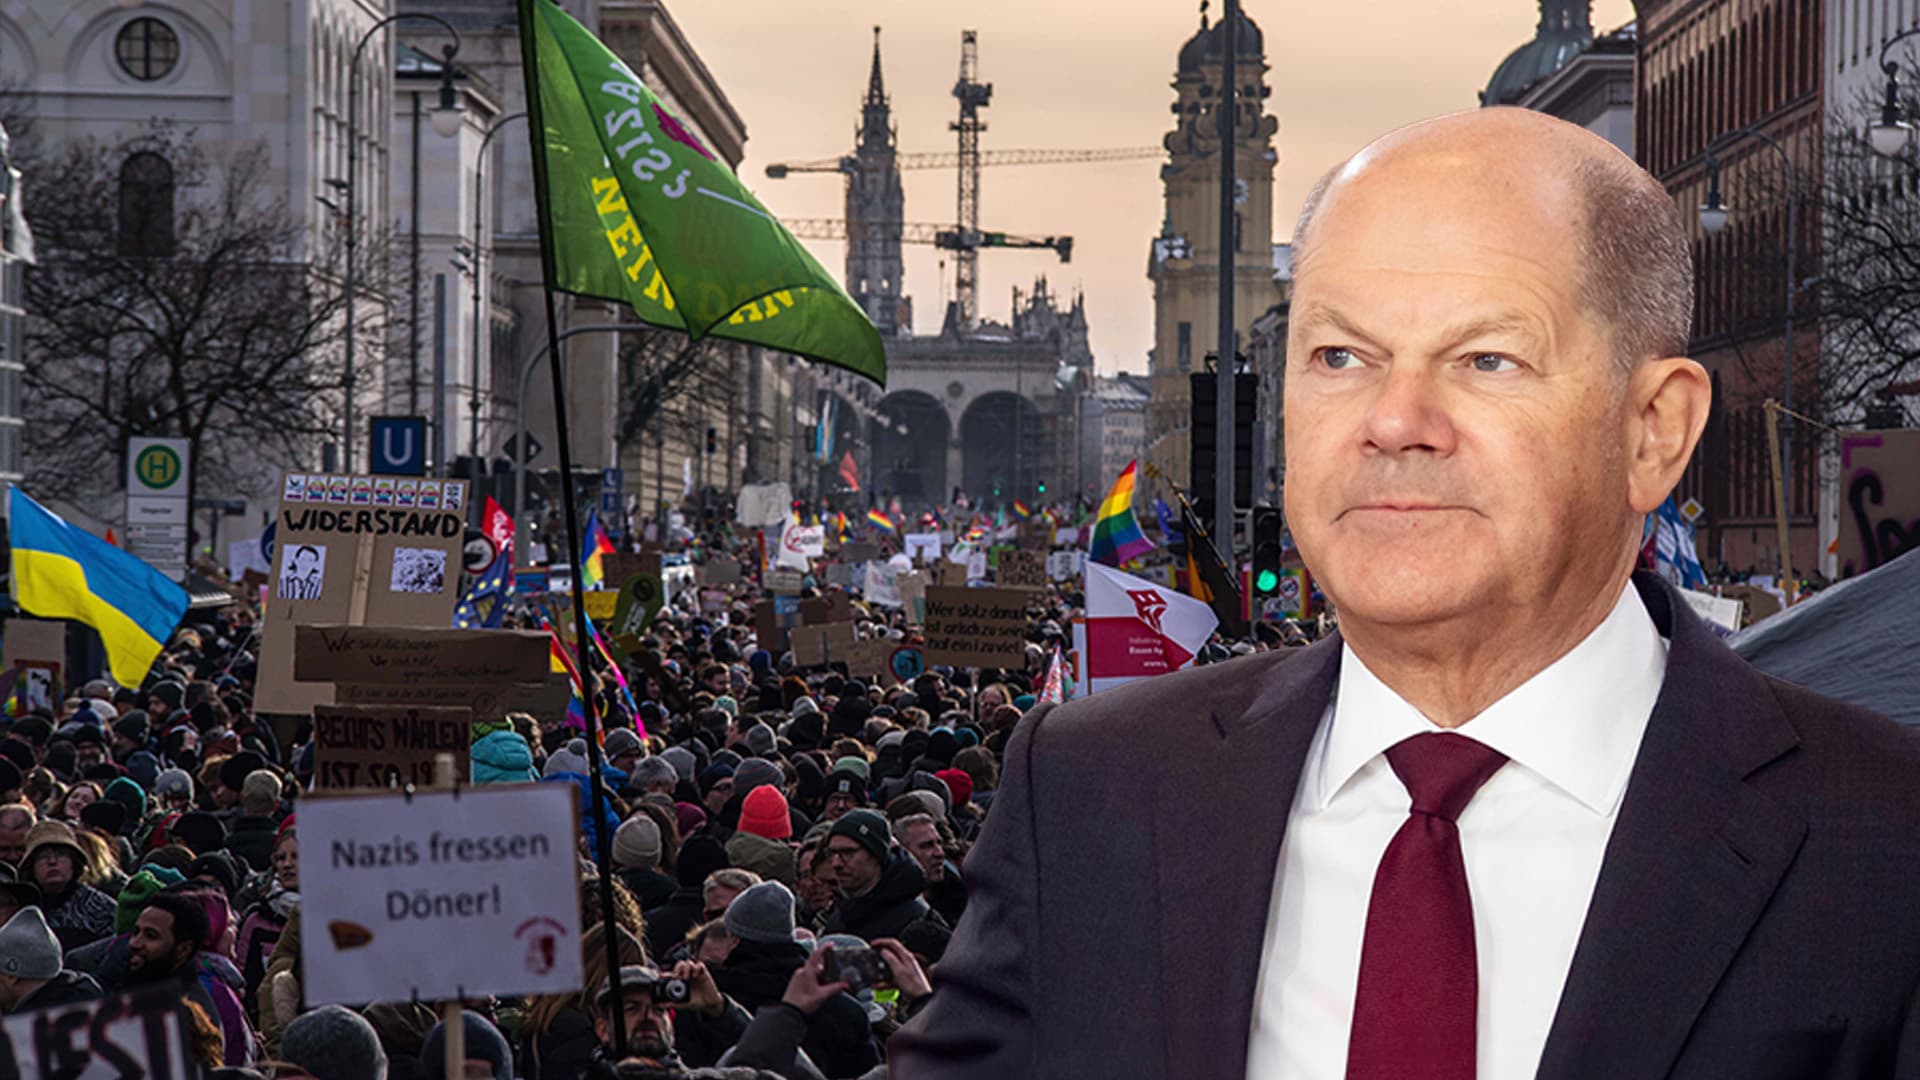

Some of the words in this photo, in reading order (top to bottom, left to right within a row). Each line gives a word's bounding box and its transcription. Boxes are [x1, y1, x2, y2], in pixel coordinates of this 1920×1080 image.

[591, 175, 676, 312] NEIN
[384, 427, 412, 466] U
[148, 455, 168, 479] H
[284, 509, 460, 537] WIDERSTAND
[926, 599, 953, 616] Wer
[959, 602, 987, 617] stolz
[928, 637, 949, 650] hat
[315, 713, 385, 751] RECHTS
[392, 709, 469, 752] WÄHLEN
[321, 761, 360, 788] IST
[368, 762, 401, 788] SO
[411, 760, 437, 786] 19
[331, 836, 420, 868] Nazis
[429, 831, 550, 862] fressen
[386, 884, 502, 921] Döner!
